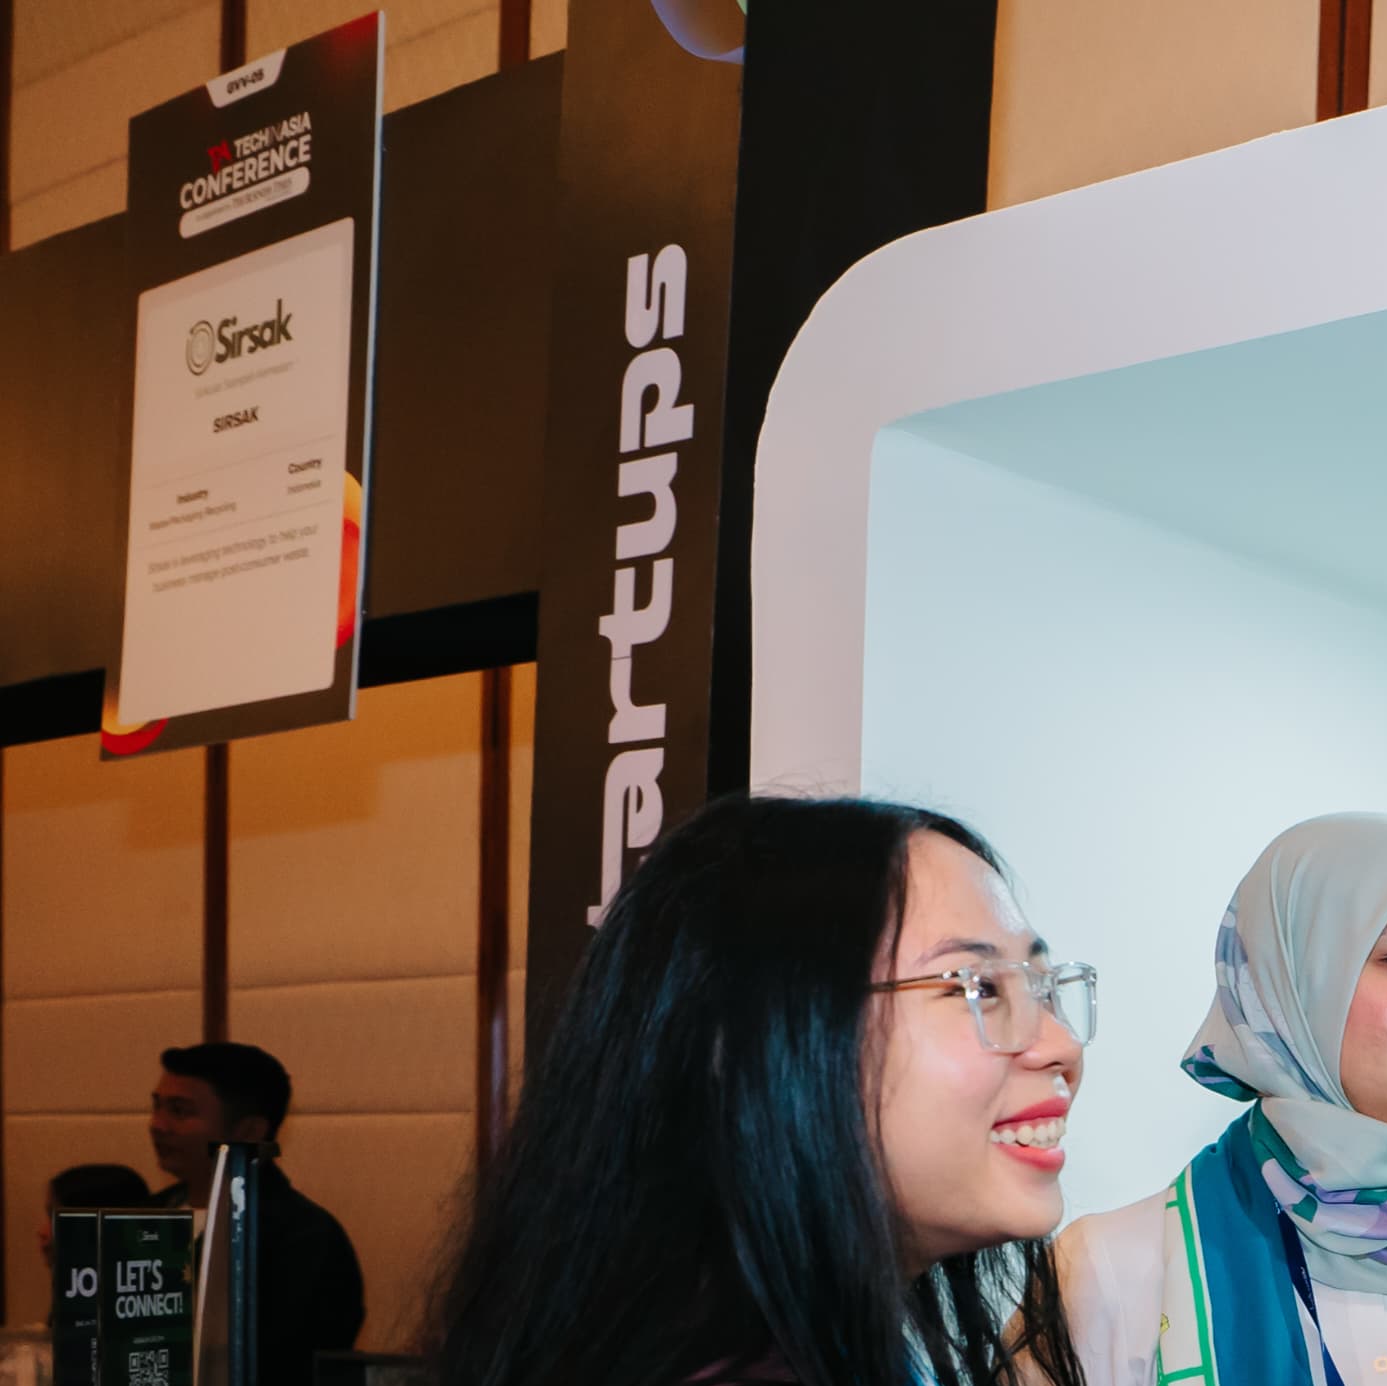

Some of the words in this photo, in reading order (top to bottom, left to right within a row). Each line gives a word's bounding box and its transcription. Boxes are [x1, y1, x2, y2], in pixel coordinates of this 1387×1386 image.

[179, 134, 312, 209] CONFERENCE
[214, 298, 293, 363] Sirsak
[212, 406, 259, 433] SIRSAK
[116, 1258, 164, 1294] LET'S
[115, 1291, 184, 1320] CONNECT!
